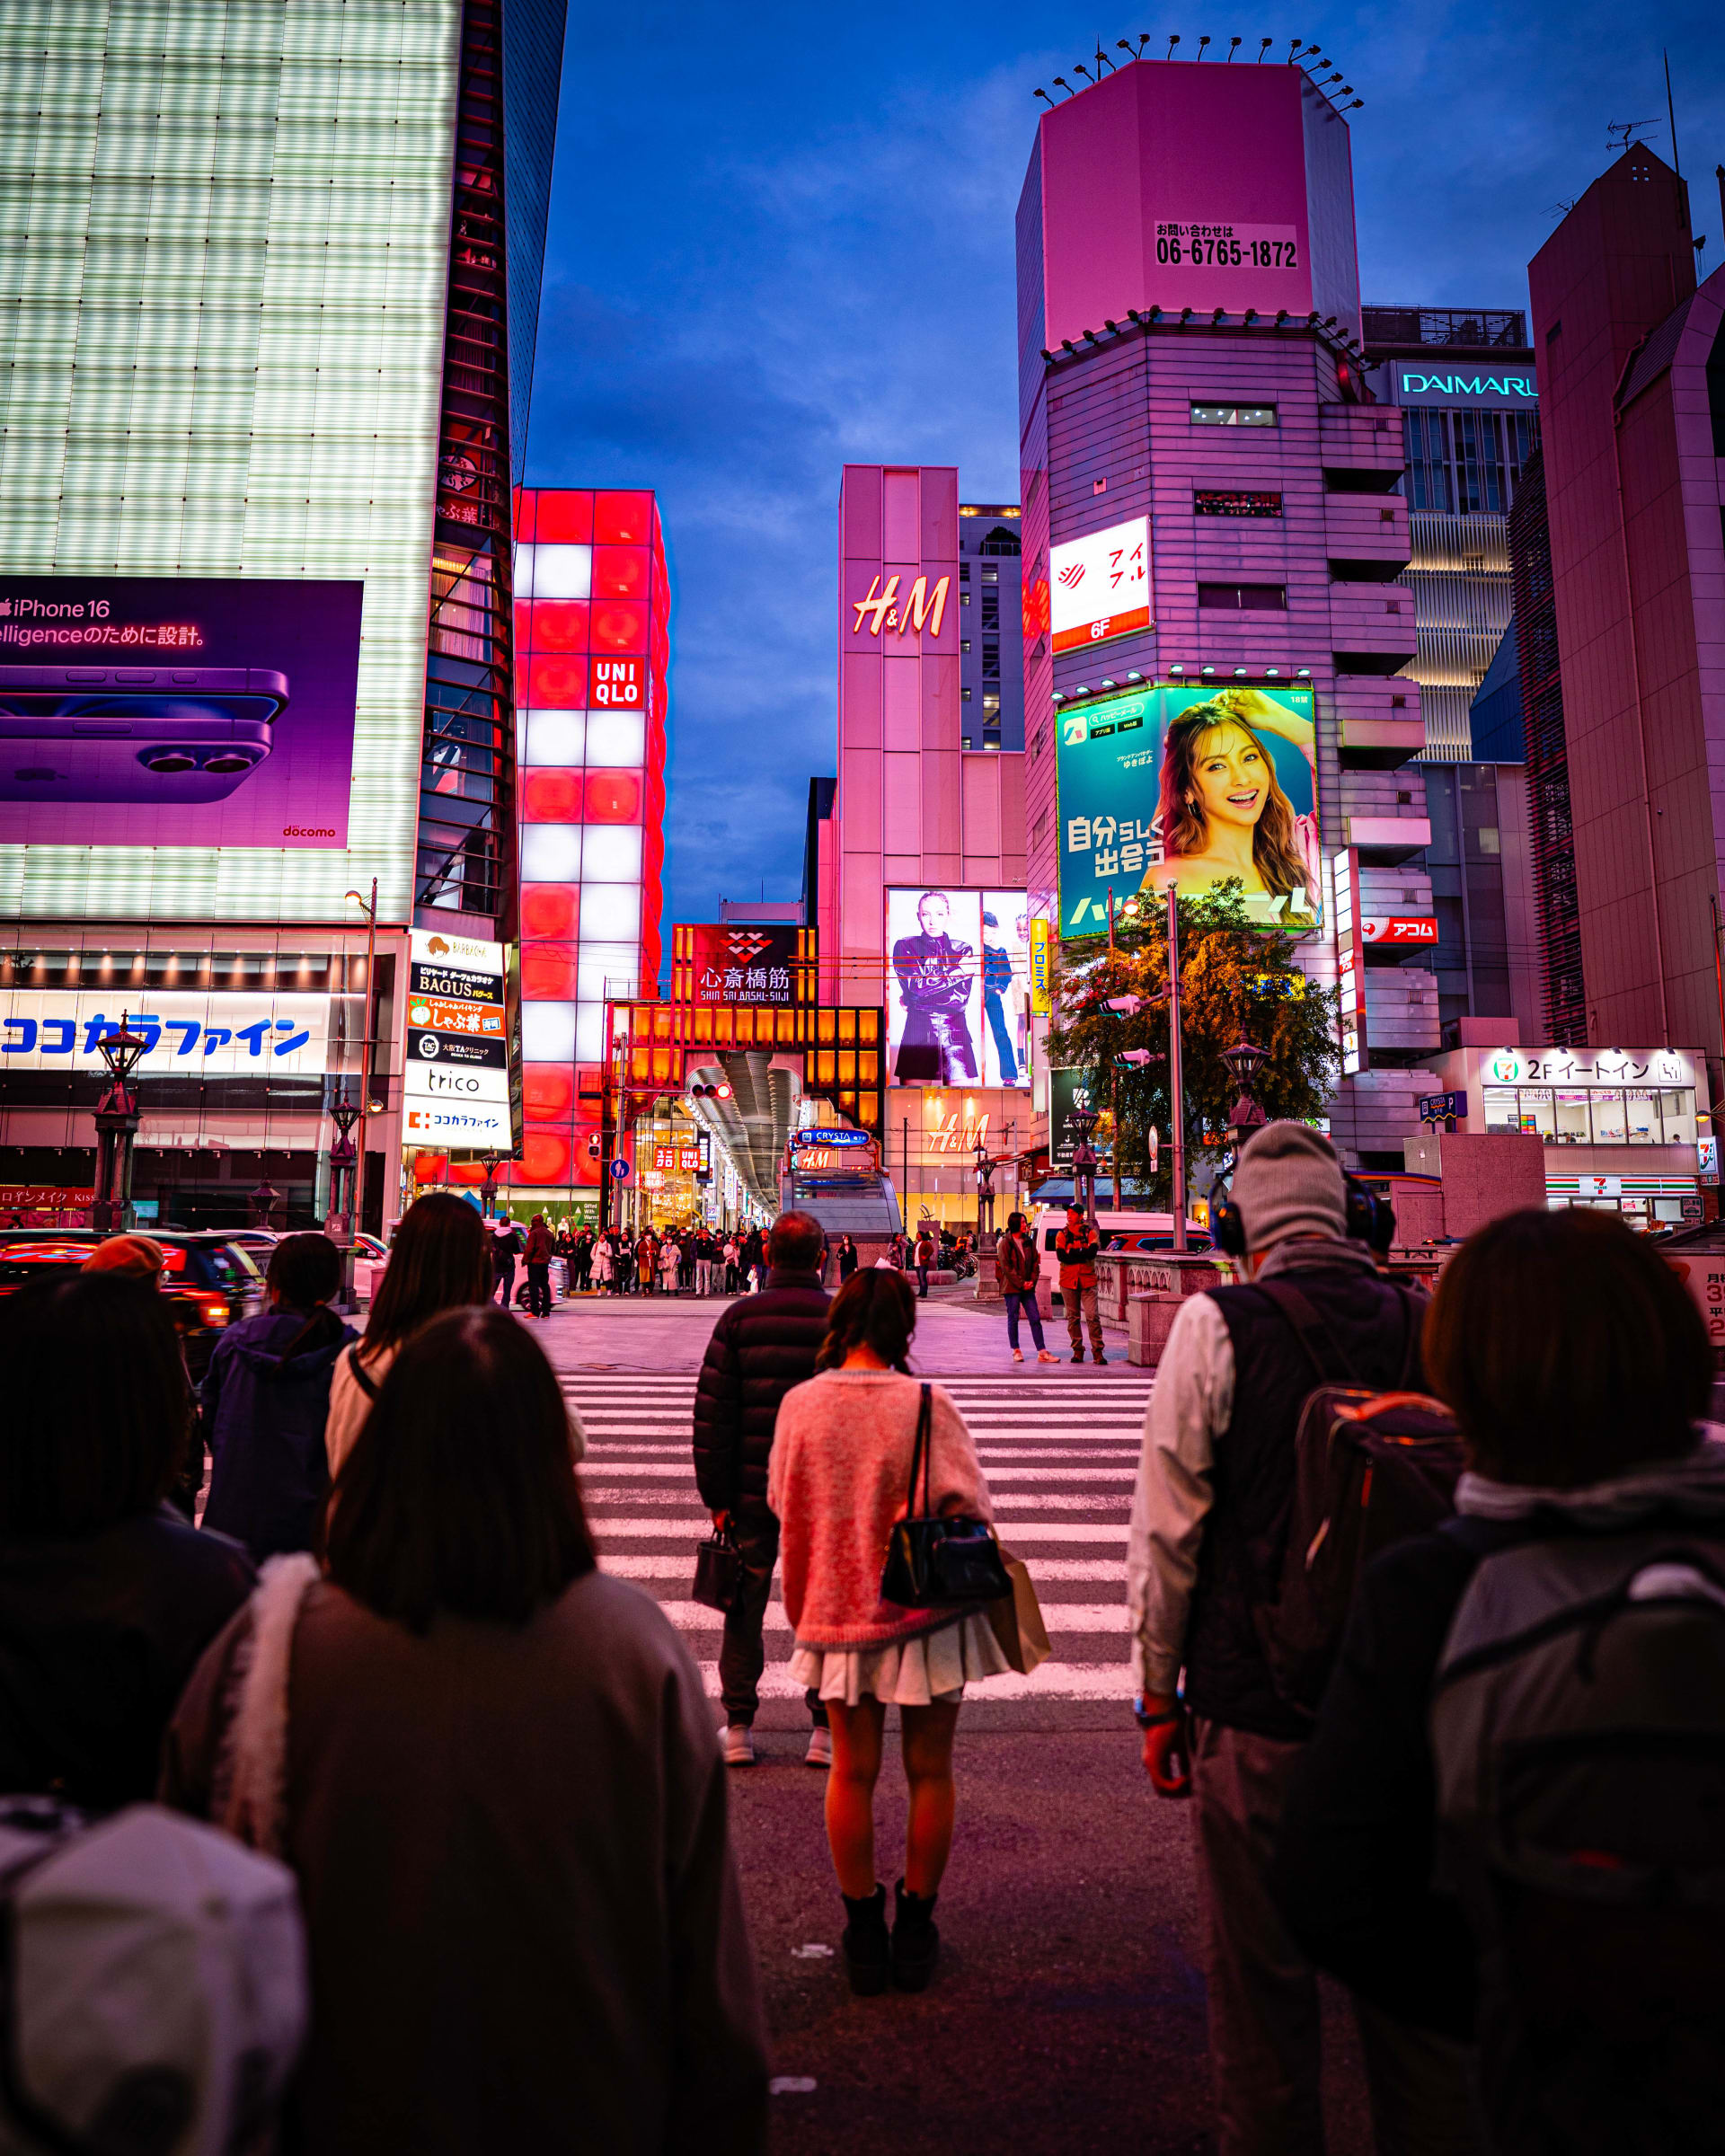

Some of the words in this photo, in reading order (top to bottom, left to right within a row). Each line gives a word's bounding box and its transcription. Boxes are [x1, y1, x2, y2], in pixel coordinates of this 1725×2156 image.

[1156, 223, 1234, 238] お問い合わせは
[1156, 237, 1297, 268] 06-6765-1872
[13, 599, 84, 617] iPhone
[88, 600, 110, 618] 16
[853, 575, 951, 637] H&M
[0, 625, 203, 647] lligenceのために設計。
[1091, 618, 1110, 639] 6F
[597, 663, 634, 682] UNI
[596, 684, 638, 704] QLO
[1101, 707, 1137, 721] ハッピーメール
[283, 826, 335, 837] docomo
[1068, 814, 1164, 853] 自分らしく
[1095, 839, 1164, 878] 出会う
[1393, 923, 1434, 936] アコム
[1034, 941, 1046, 989] プロミス
[420, 976, 472, 997] BAGUS
[700, 967, 790, 989] 心斎橋筋
[433, 1008, 481, 1032] しゃぶ葉
[1, 1014, 310, 1056] ココカラファイン
[429, 1068, 479, 1091] trico
[1527, 1059, 1552, 1080] 2F
[1558, 1061, 1649, 1080] イートイン
[1448, 1097, 1454, 1109] P
[434, 1115, 499, 1128] ココカラファイン
[816, 1132, 850, 1140] CRYSTA
[928, 1113, 990, 1153] H&M
[656, 1158, 673, 1168] クロ
[657, 1150, 673, 1159] ユニ
[682, 1151, 697, 1160] UNI
[682, 1160, 698, 1169] QLO
[1707, 1284, 1725, 1303] 3
